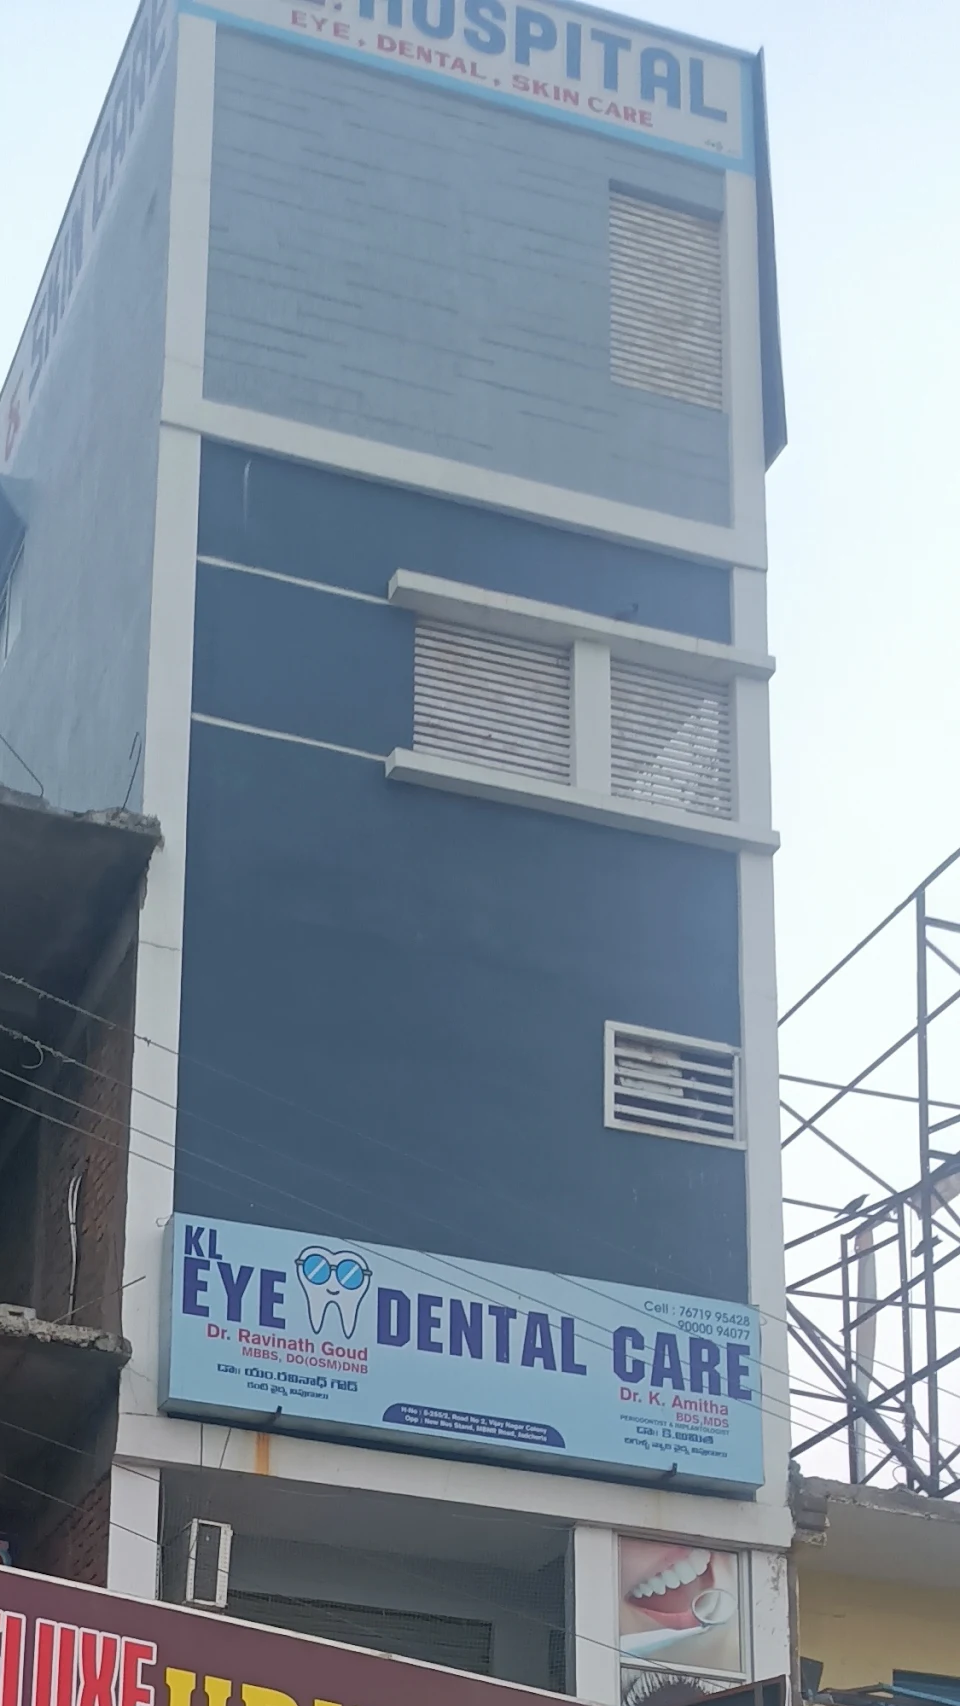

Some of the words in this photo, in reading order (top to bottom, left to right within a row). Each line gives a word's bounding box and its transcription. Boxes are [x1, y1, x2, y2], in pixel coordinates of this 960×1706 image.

[512, 74, 580, 107] SKIN
[587, 96, 654, 127] CARE
[184, 1225, 222, 1260] KL
[182, 1256, 287, 1330] EYE
[377, 1287, 587, 1375] DENTAL
[612, 1325, 753, 1401] CARE
[644, 1300, 669, 1314] Cell
[679, 1305, 712, 1320] 76719
[715, 1311, 750, 1327] 95428
[207, 1323, 231, 1340] Dr.
[238, 1328, 315, 1353] Ravinath
[321, 1341, 368, 1361] Goud
[678, 1320, 713, 1335] 90000
[716, 1326, 750, 1340] 94077
[242, 1346, 282, 1363] MBBS,
[620, 1386, 642, 1403] Dr.
[649, 1391, 666, 1407] K.
[671, 1395, 729, 1416] Amitha
